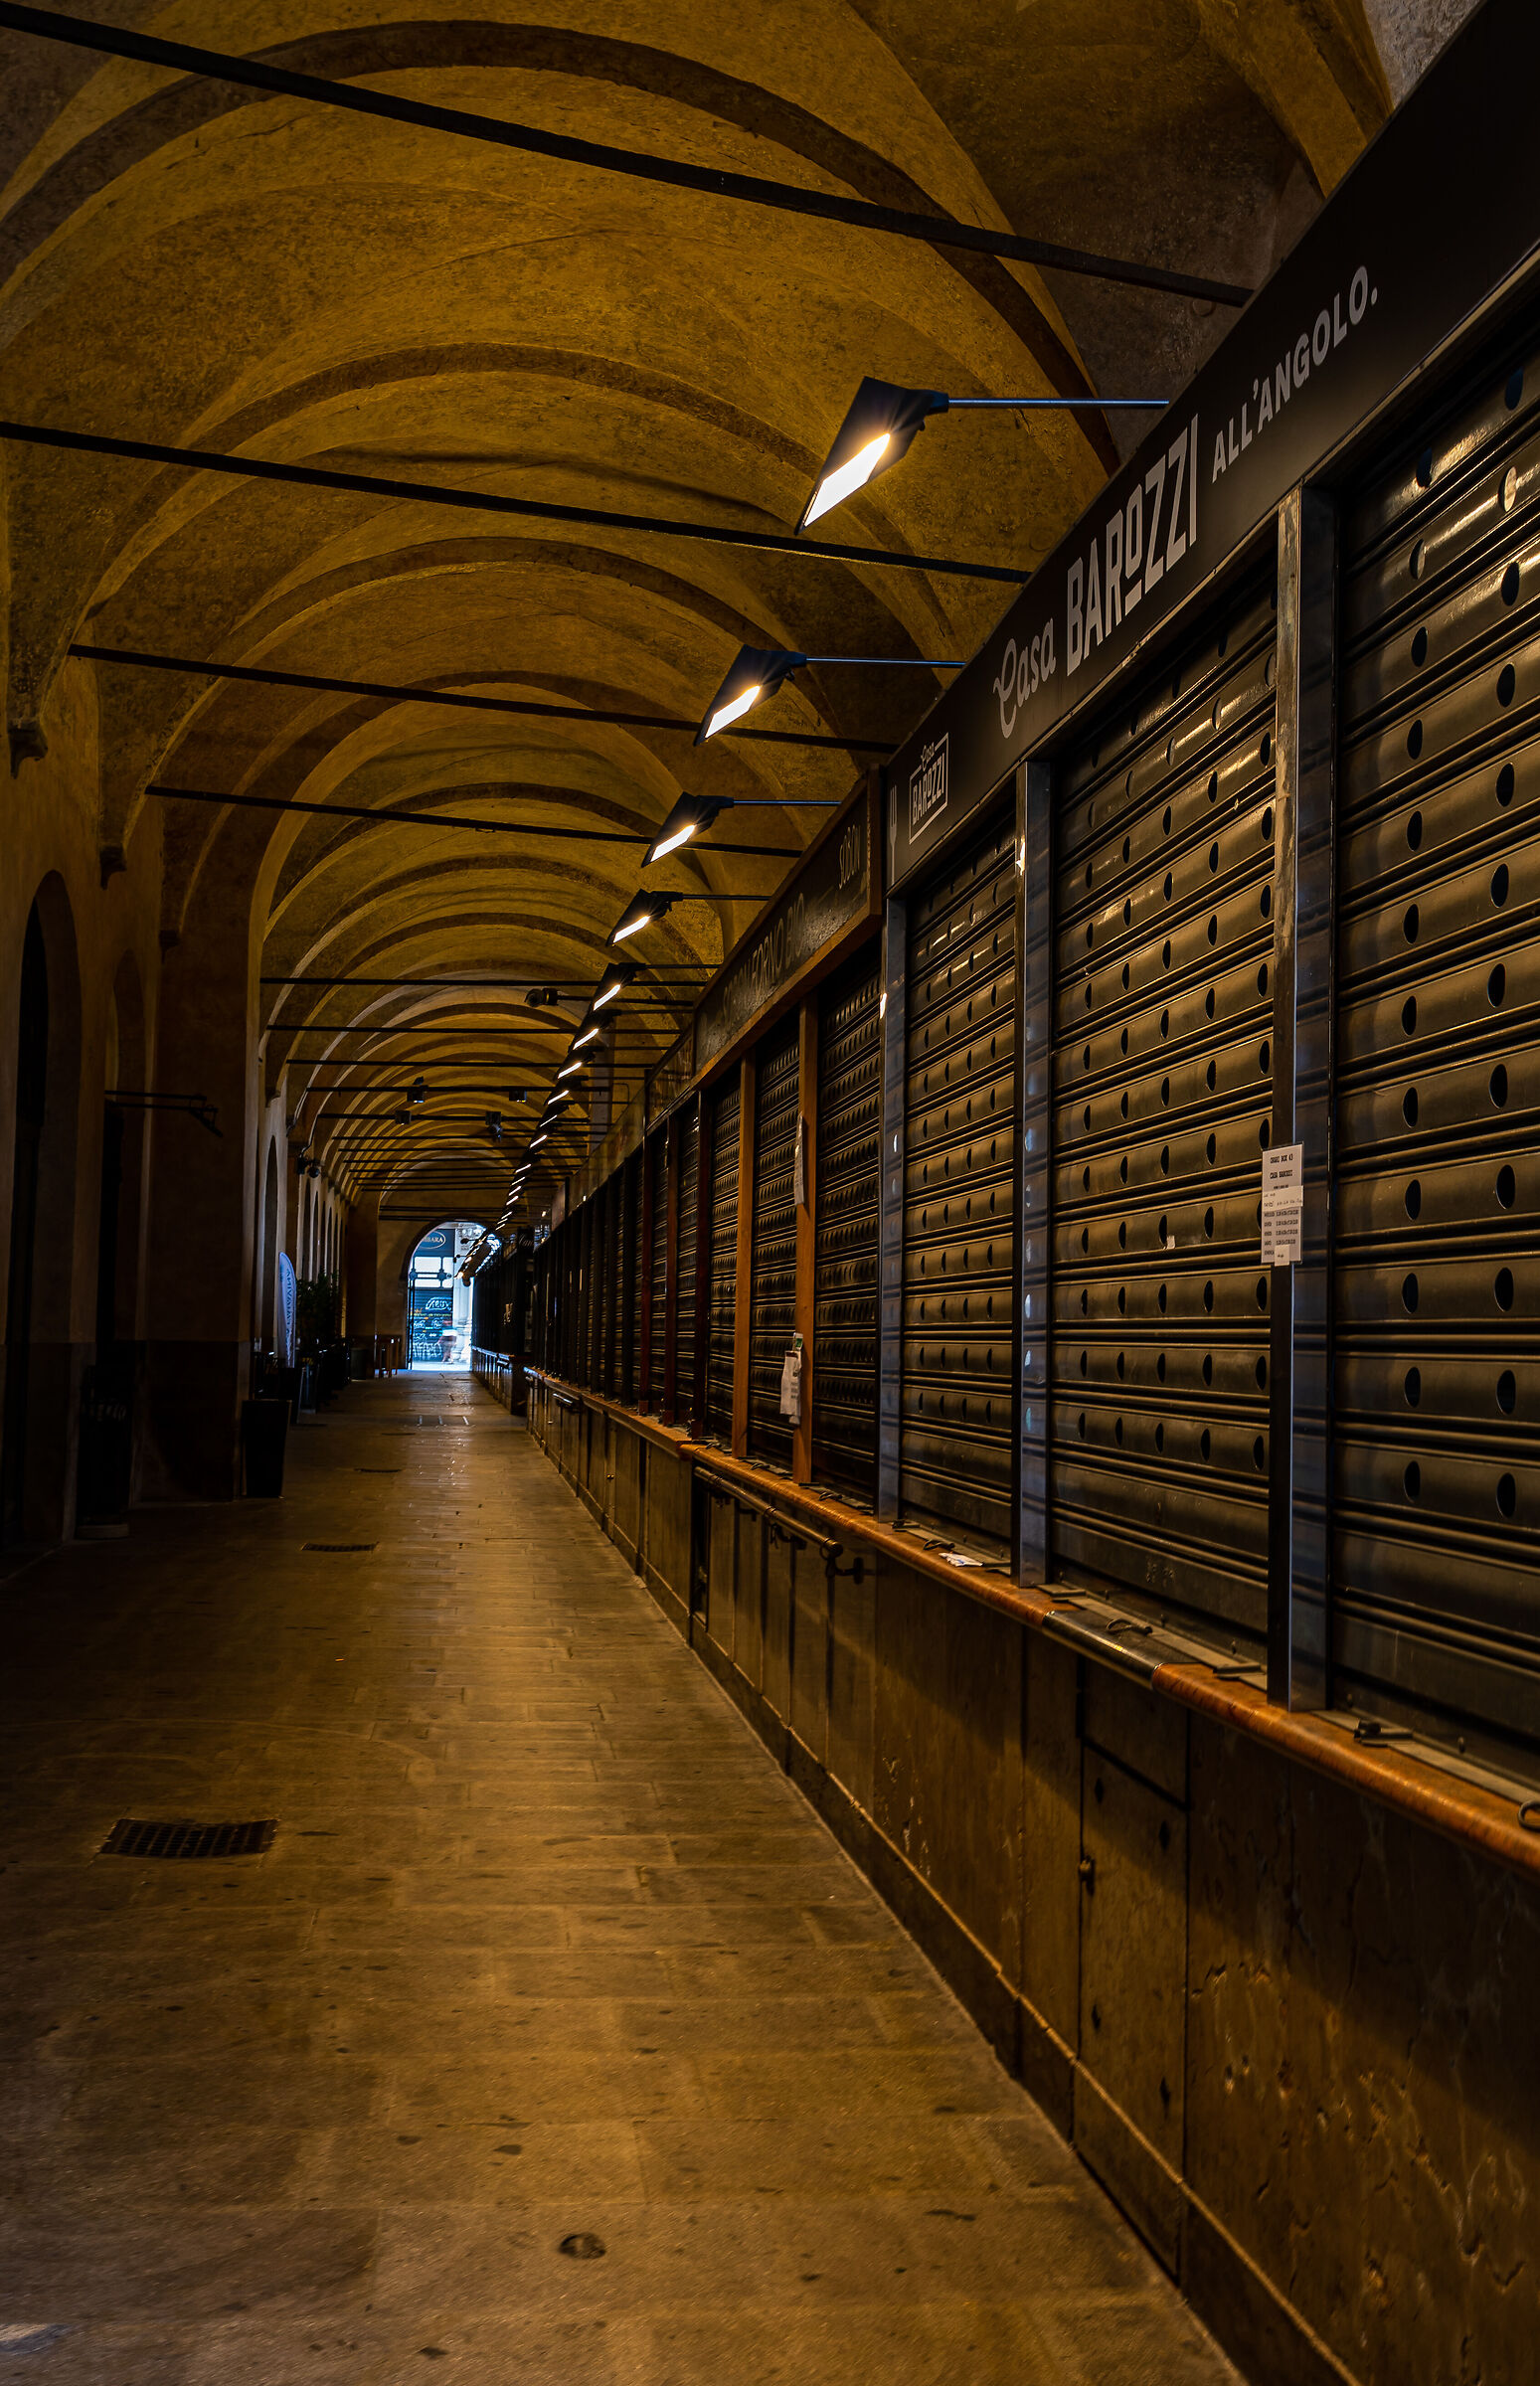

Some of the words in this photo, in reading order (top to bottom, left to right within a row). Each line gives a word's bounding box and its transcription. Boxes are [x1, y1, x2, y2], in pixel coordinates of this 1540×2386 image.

[992, 617, 1057, 739] Casa
[1067, 413, 1199, 677] BAROZZI
[1211, 264, 1379, 484] ALL'ANGOLO.
